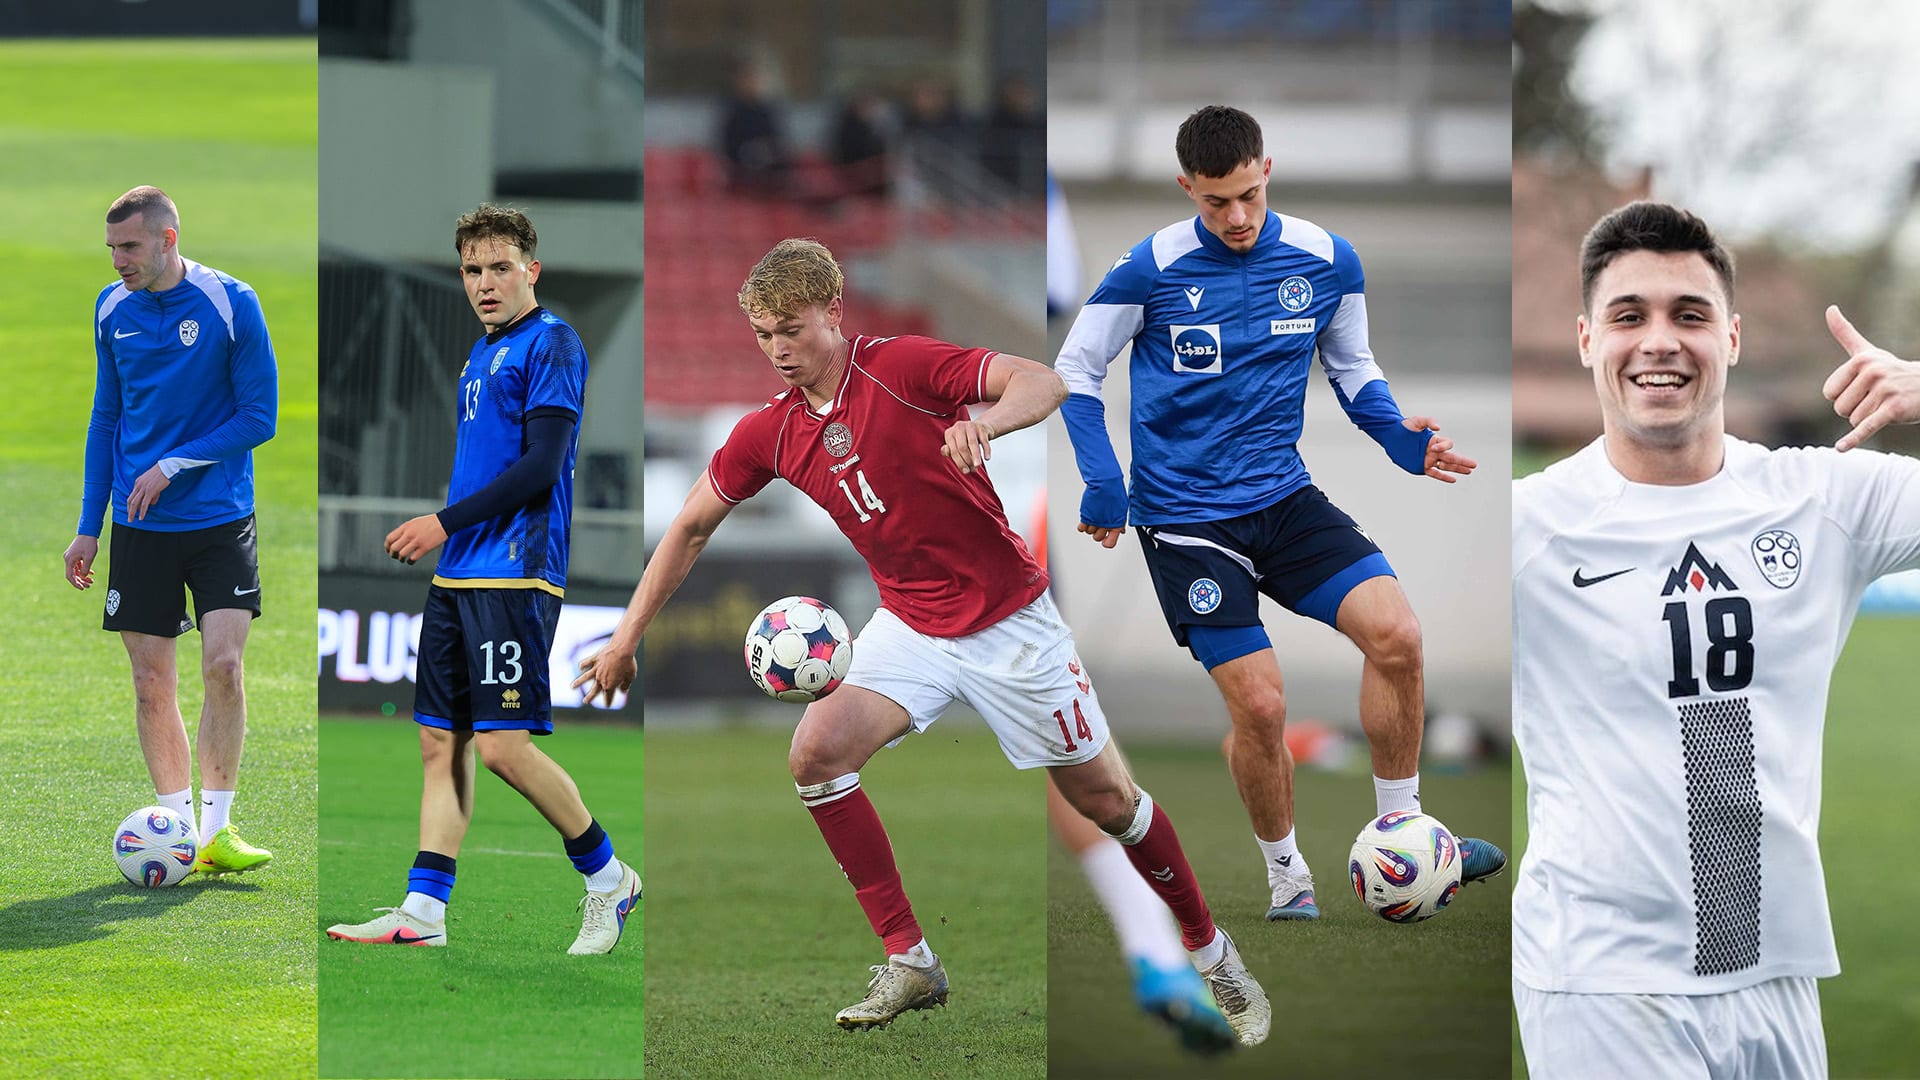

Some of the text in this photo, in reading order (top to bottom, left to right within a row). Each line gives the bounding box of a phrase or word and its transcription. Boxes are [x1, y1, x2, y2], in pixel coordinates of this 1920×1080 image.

[1274, 322, 1312, 330] FORTUNA
[464, 378, 481, 422] 13
[839, 470, 886, 523] 14
[480, 640, 523, 685] 13
[1662, 596, 1755, 698] 18
[1053, 697, 1094, 753] 14
